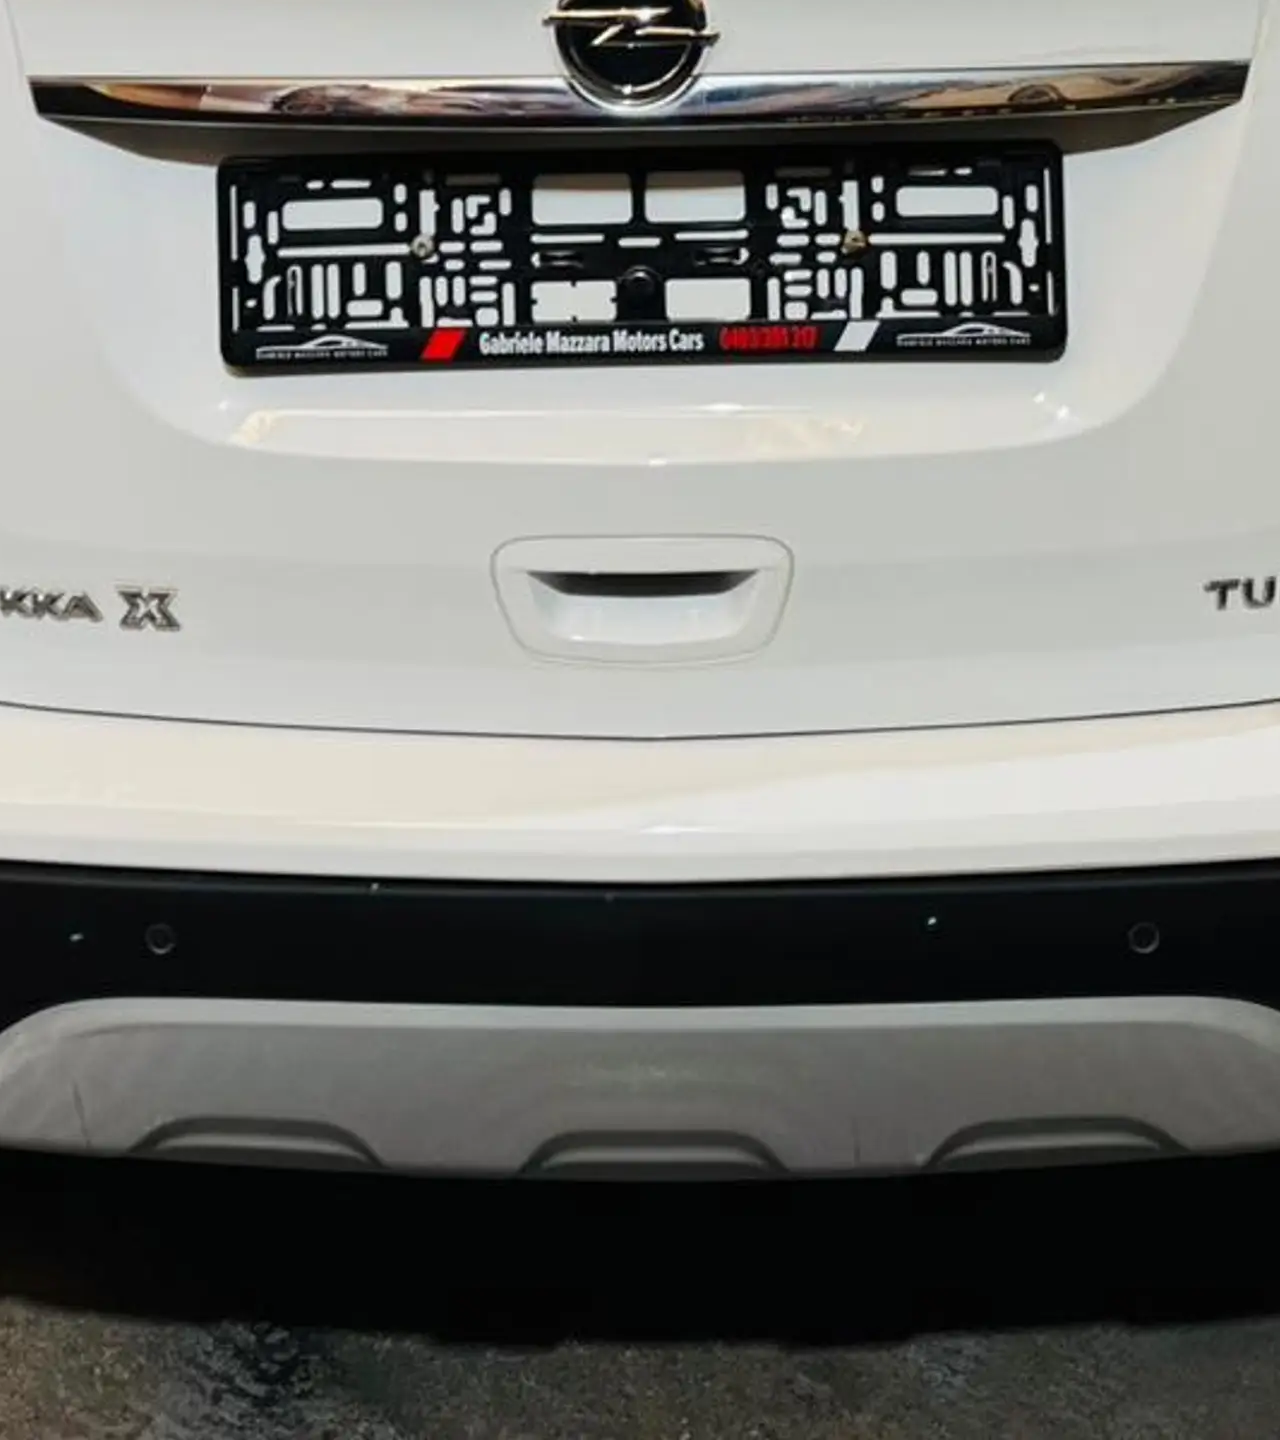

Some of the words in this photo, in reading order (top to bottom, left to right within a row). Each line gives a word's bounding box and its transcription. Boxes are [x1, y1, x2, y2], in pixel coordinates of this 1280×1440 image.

[479, 330, 542, 355] Gabriele
[546, 329, 610, 353] Mazzara
[613, 328, 667, 352] Motors
[669, 327, 704, 351] Cars
[117, 586, 181, 631] X
